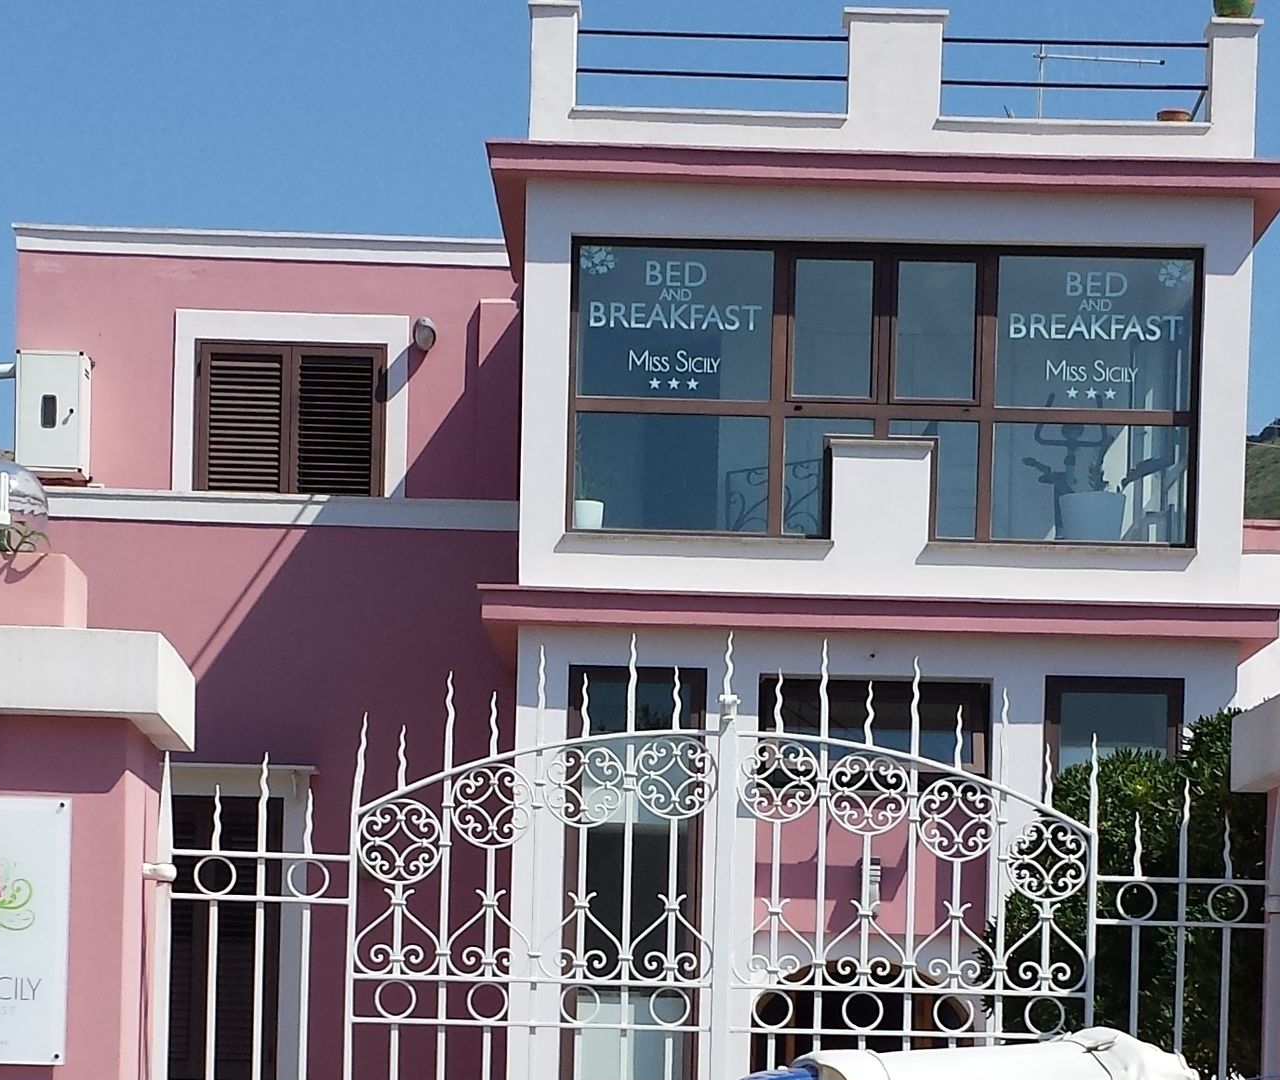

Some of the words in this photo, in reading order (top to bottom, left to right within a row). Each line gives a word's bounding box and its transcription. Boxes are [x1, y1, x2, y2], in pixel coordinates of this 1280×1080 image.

[645, 260, 708, 287] BED
[1065, 271, 1128, 297] BED
[658, 288, 692, 301] AND
[1078, 299, 1113, 312] AND
[589, 301, 762, 331] BREAKFAST
[1009, 313, 1184, 341] BREAKFAST
